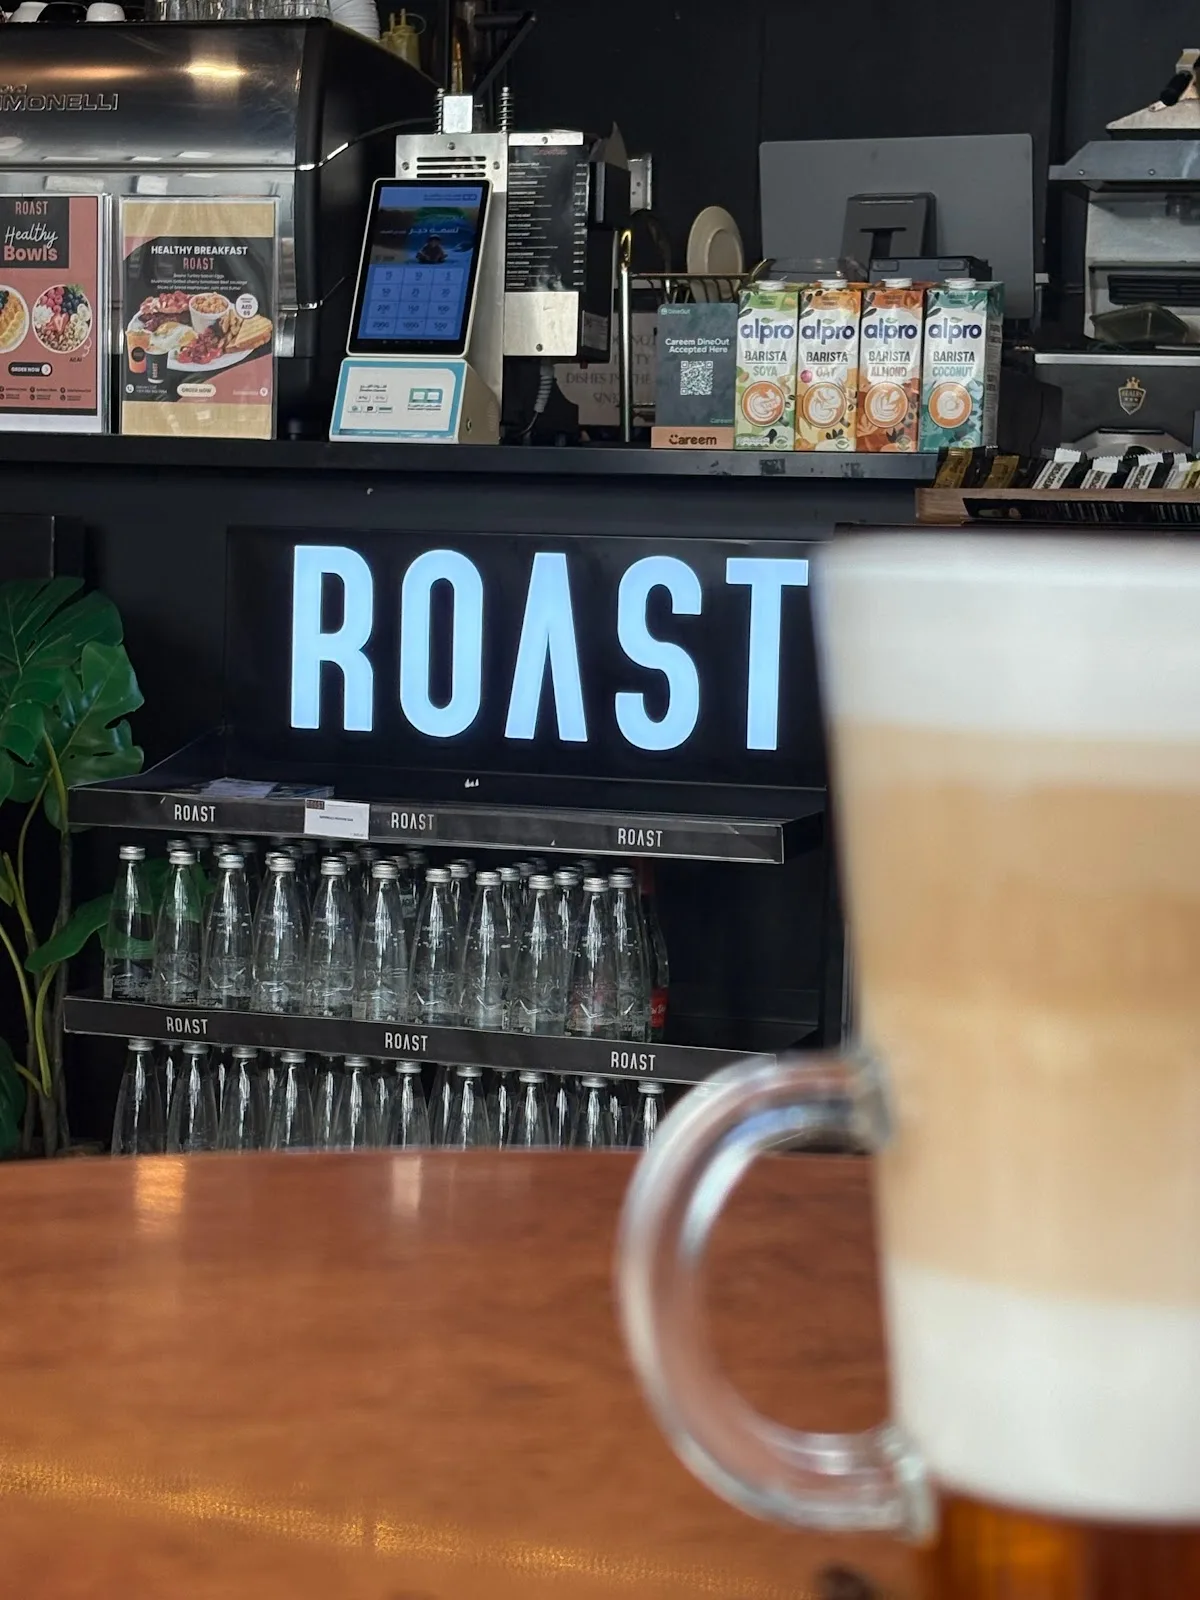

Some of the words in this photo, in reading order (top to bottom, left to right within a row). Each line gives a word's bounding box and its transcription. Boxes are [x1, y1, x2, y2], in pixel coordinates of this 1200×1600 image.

[15, 201, 48, 215] ROAST
[5, 222, 58, 249] Healthy
[4, 244, 58, 261] Bowls
[151, 245, 193, 255] HEALTHY
[195, 246, 248, 255] BREAKFAST
[183, 257, 215, 270] ROAST
[740, 318, 794, 345] alpro
[801, 318, 855, 345] alpro
[864, 318, 918, 345] alpro
[928, 317, 982, 345] alpro
[665, 338, 696, 346] Careem
[697, 338, 730, 346] DineOut
[668, 346, 707, 355] Accepted
[744, 350, 787, 362] BARISTA
[806, 351, 848, 362] BARISTA
[868, 351, 911, 362] BARISTA
[933, 350, 975, 362] BARISTA
[753, 365, 778, 377] SOYA
[816, 366, 837, 377] OAT
[870, 366, 907, 377] ALMOND
[932, 366, 973, 377] COCONUT
[668, 434, 717, 445] Careem
[291, 544, 809, 751] ROAST
[174, 804, 216, 823] ROAST
[391, 812, 434, 831] ROAST
[617, 828, 663, 848] ROAST
[166, 1016, 208, 1035] ROAST
[384, 1032, 429, 1052] ROAST
[611, 1051, 656, 1071] ROAST
